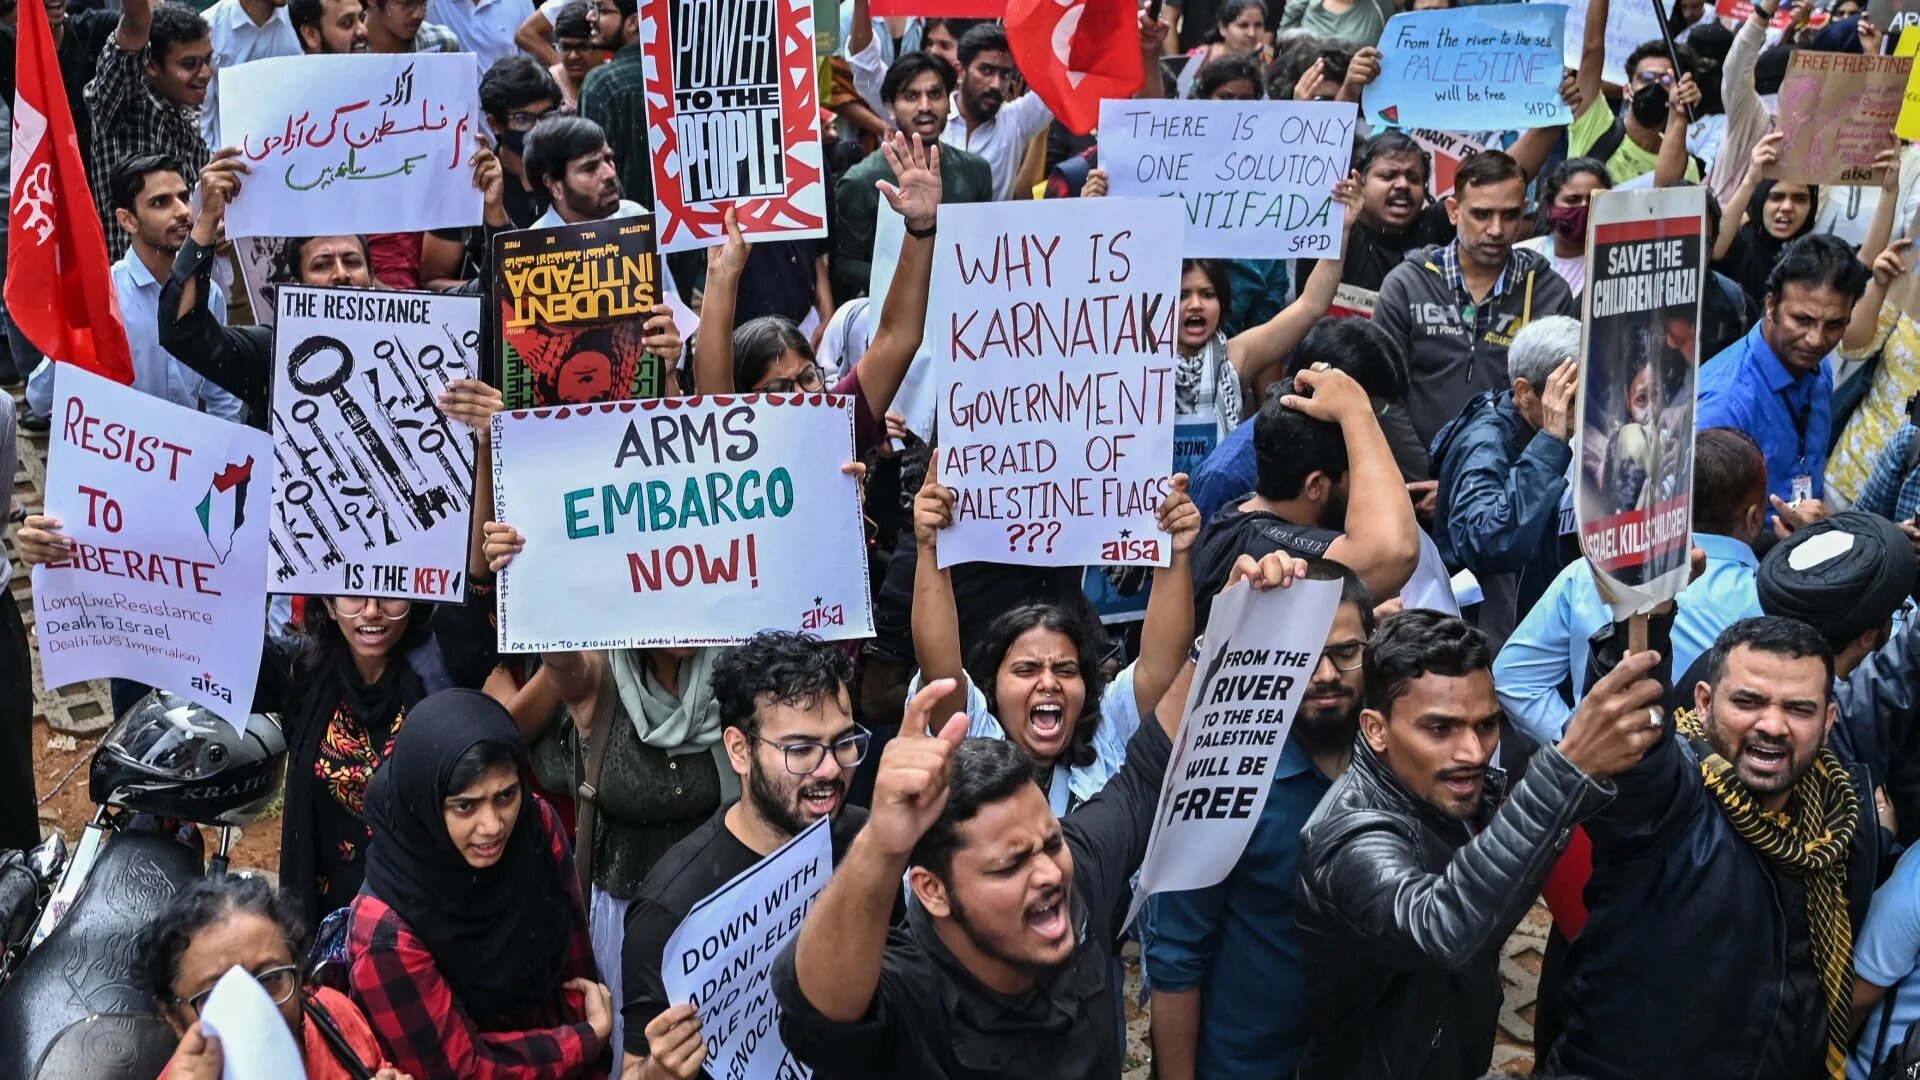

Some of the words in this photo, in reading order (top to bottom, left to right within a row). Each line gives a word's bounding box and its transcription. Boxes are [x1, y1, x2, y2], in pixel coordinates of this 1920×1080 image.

[675, 0, 775, 90] POWER
[1396, 25, 1429, 48] From
[1437, 26, 1459, 48] the
[1465, 34, 1497, 46] river
[1501, 29, 1511, 45] to
[1515, 29, 1531, 46] the
[1535, 35, 1552, 48] sea
[1403, 52, 1549, 85] PALESTINE
[1792, 54, 1830, 71] FREE
[1833, 55, 1911, 74] PALESTINE
[675, 91, 713, 111] TO
[717, 87, 780, 108] THE
[1435, 85, 1460, 101] will
[1467, 85, 1480, 101] be
[1485, 87, 1507, 101] free
[1125, 111, 1209, 140] THERE
[1231, 112, 1259, 141] IS
[1280, 115, 1354, 148] ONLY
[1415, 127, 1457, 151] MANY
[678, 108, 784, 202] PEOPLE
[1136, 153, 1194, 183] ONE
[1215, 151, 1348, 187] SOLUTION
[1158, 190, 1333, 231] NTIFADA
[504, 240, 521, 250] FREE
[580, 231, 596, 240] WILL
[504, 252, 654, 298] INTIFADA
[955, 233, 1061, 292] WHY
[1088, 230, 1132, 285] IS
[1607, 242, 1654, 276] SAVE
[1654, 239, 1683, 269] THE
[284, 291, 317, 318] THE
[323, 293, 431, 325] RESISTANCE
[505, 283, 654, 329] STUDENT
[1592, 274, 1653, 319] CHILDREN
[1653, 270, 1666, 309] OF
[1665, 267, 1697, 307] GAZA
[951, 292, 1176, 363] KARNATAKA
[949, 365, 1173, 431] GOVERNMENT
[64, 396, 193, 482] RESIST
[613, 405, 760, 469] ARMS
[945, 439, 1057, 478] AFRAID
[1085, 434, 1136, 473] OF
[78, 484, 123, 533] TO
[563, 466, 794, 540] EMBARGO
[1102, 476, 1170, 518] FLAGS
[1006, 521, 1062, 554] ???
[1100, 530, 1160, 562] aisa
[1585, 527, 1618, 563] ISRAEL
[1619, 519, 1651, 556] KILLS
[1650, 505, 1688, 547] CHILDREN
[344, 563, 364, 590] IS
[372, 564, 408, 593] THE
[413, 567, 450, 596] KEY
[626, 533, 759, 593] NOW!
[801, 598, 845, 630] aisa
[1222, 649, 1271, 669] FROM
[1273, 650, 1310, 668] THE
[190, 672, 233, 705] aisa
[1210, 674, 1294, 706] RIVER
[1202, 711, 1220, 729] TO
[1222, 709, 1254, 725] THE
[1255, 708, 1284, 724] SEA
[1193, 730, 1278, 751] PALESTINE
[1185, 756, 1230, 780] WILL
[1236, 756, 1269, 776] BE
[1167, 786, 1259, 828] FREE
[681, 903, 758, 977] DOWN
[765, 856, 819, 917] WITH
[688, 885, 826, 1009] ADANI-ELBIT
[744, 988, 769, 1020] IN
